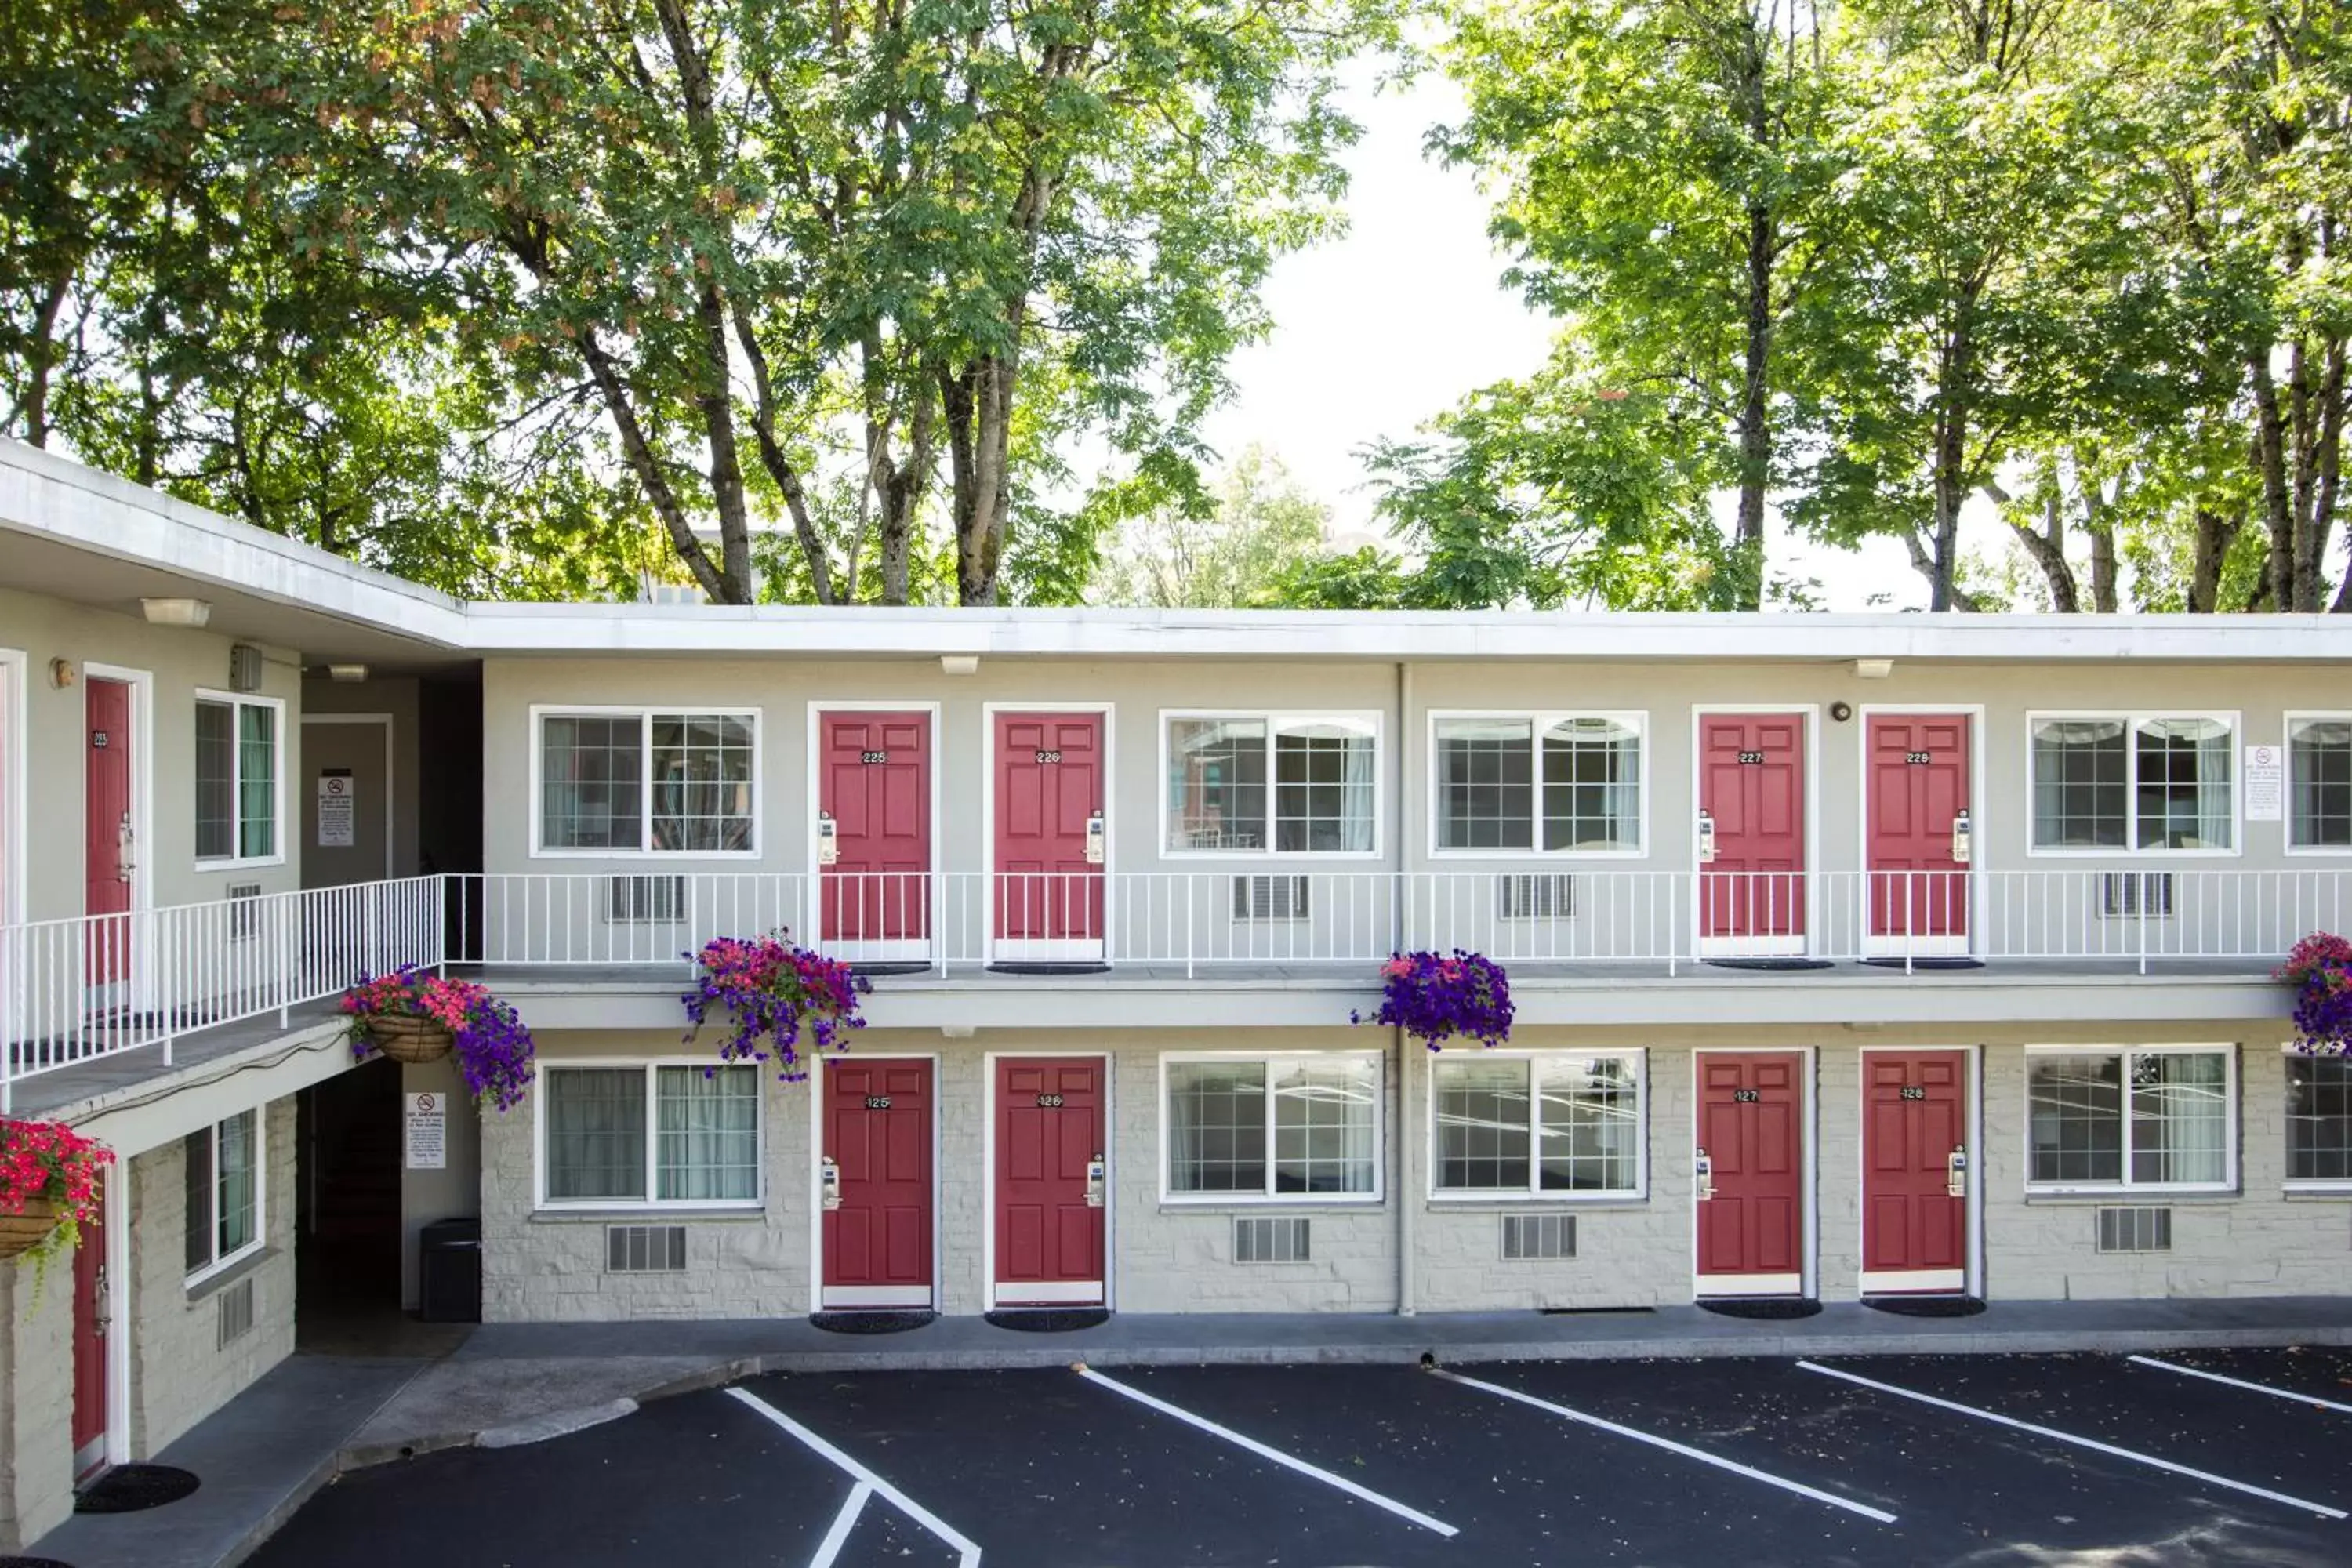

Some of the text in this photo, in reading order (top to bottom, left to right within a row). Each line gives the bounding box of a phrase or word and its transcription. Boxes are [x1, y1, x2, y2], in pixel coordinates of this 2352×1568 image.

[1037, 752, 1059, 763] 226
[1740, 753, 1761, 763] 227
[1907, 753, 1928, 763] 228
[1039, 1095, 1061, 1106] 126
[1737, 1091, 1757, 1102] 127
[867, 1097, 889, 1108] 125
